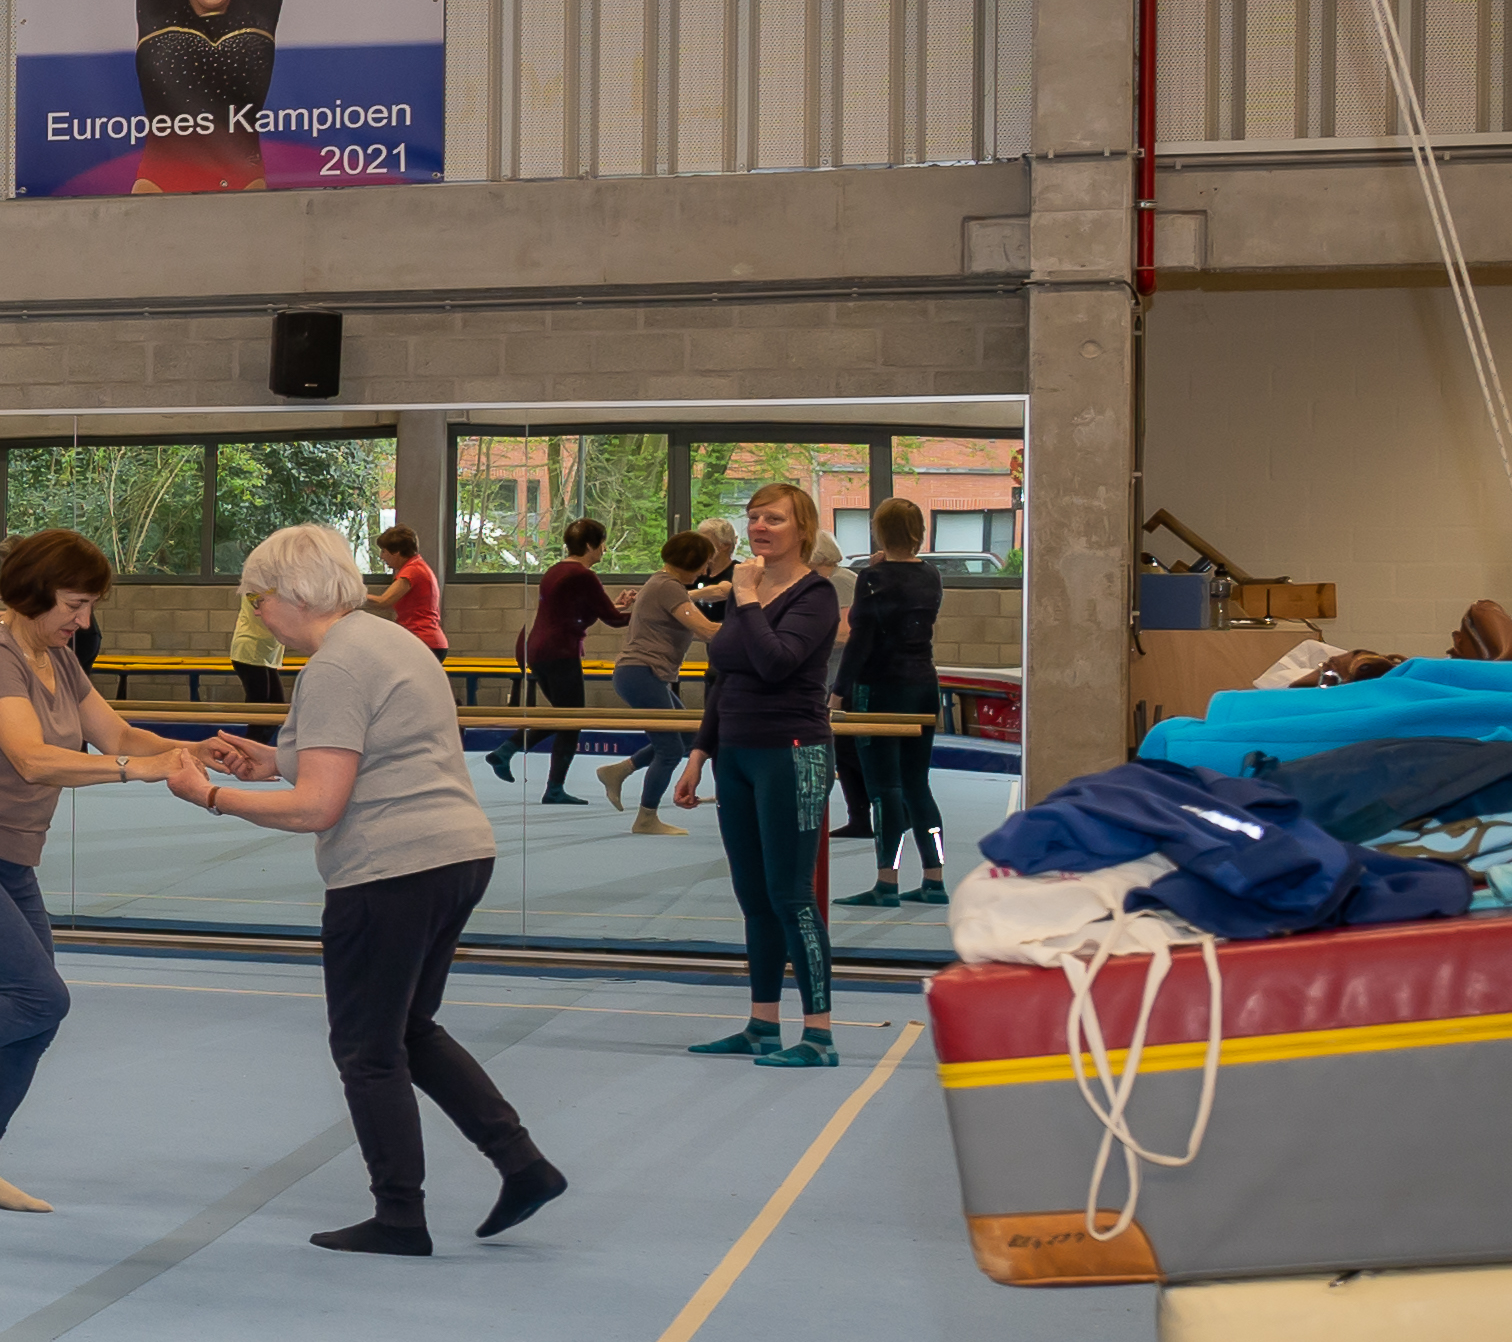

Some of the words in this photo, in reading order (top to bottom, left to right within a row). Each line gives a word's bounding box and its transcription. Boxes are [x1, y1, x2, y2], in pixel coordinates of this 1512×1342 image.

[47, 111, 215, 144] Europees
[229, 99, 411, 141] Kampioen
[319, 143, 406, 176] 2021
